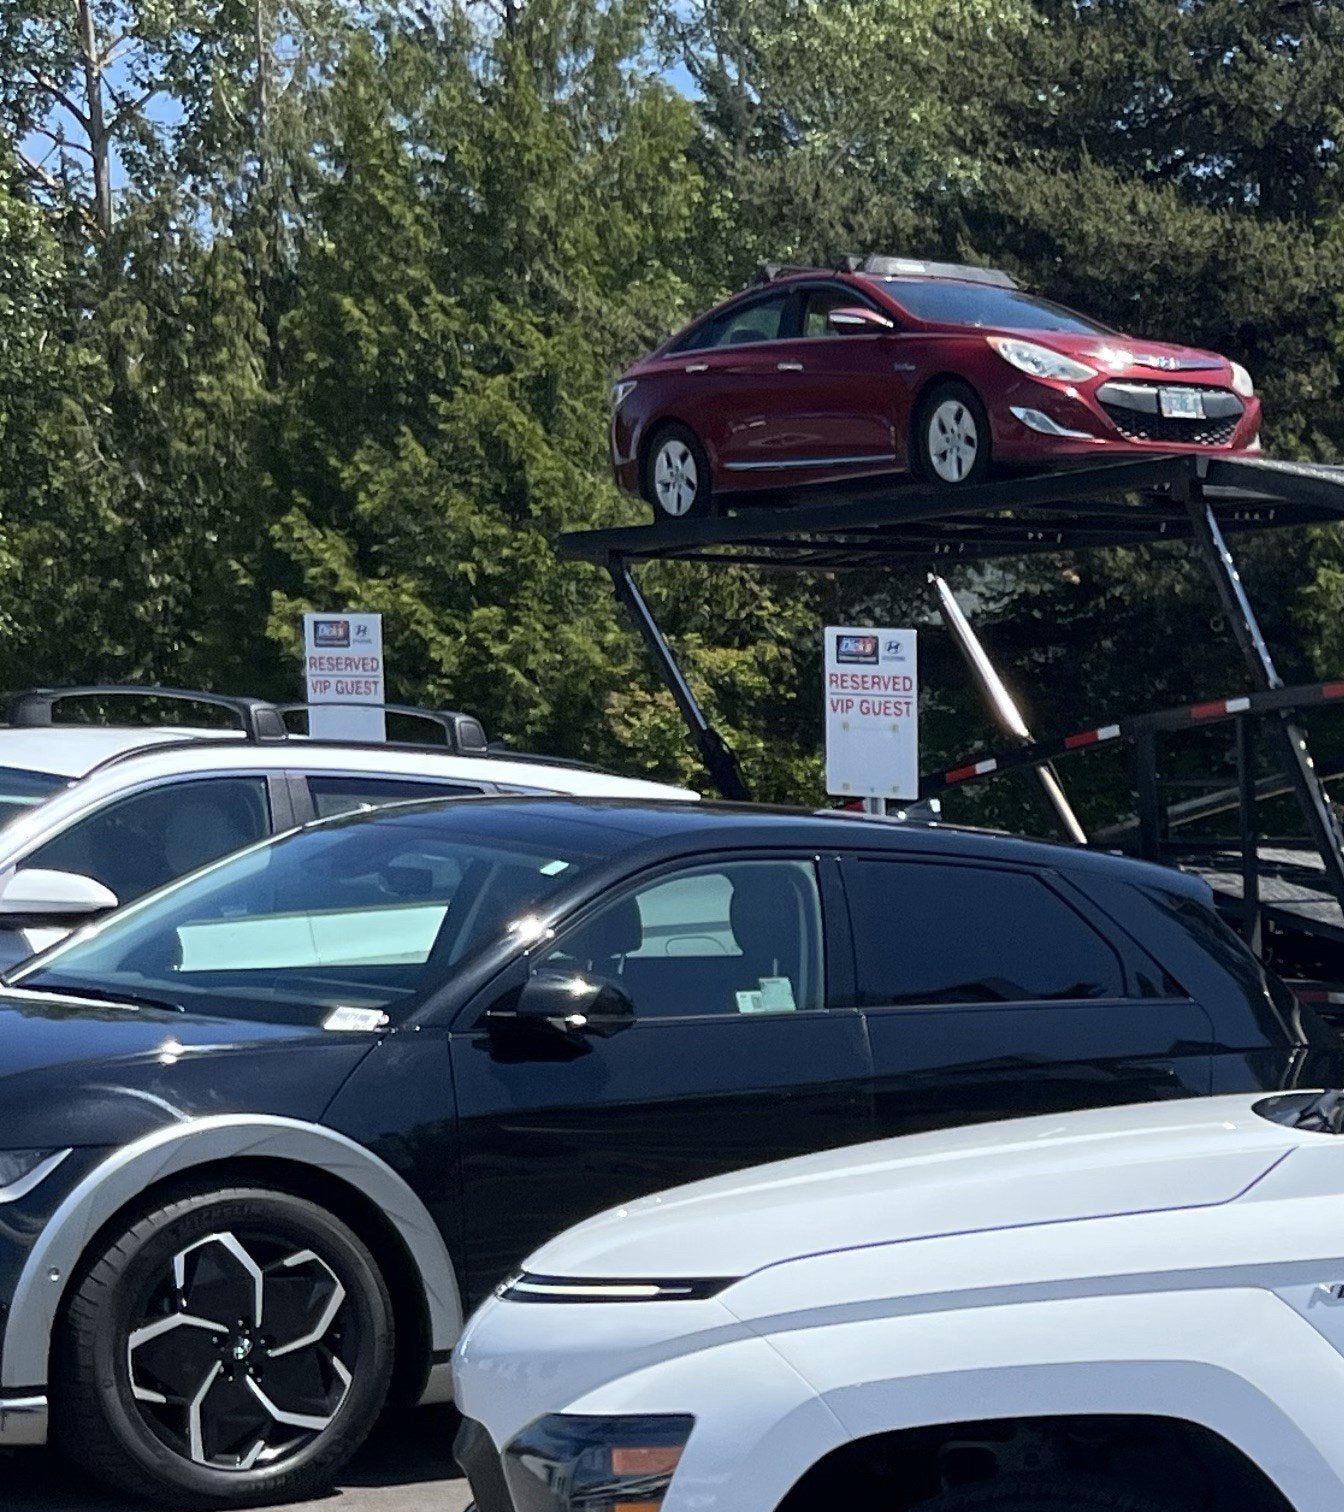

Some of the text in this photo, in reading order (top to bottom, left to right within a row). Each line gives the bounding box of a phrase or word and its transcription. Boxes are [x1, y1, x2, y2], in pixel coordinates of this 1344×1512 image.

[308, 656, 380, 673] RESERVED
[311, 679, 380, 696] VIP GUEST
[828, 673, 913, 692] RESERVED
[830, 697, 913, 718] VIP GUEST
